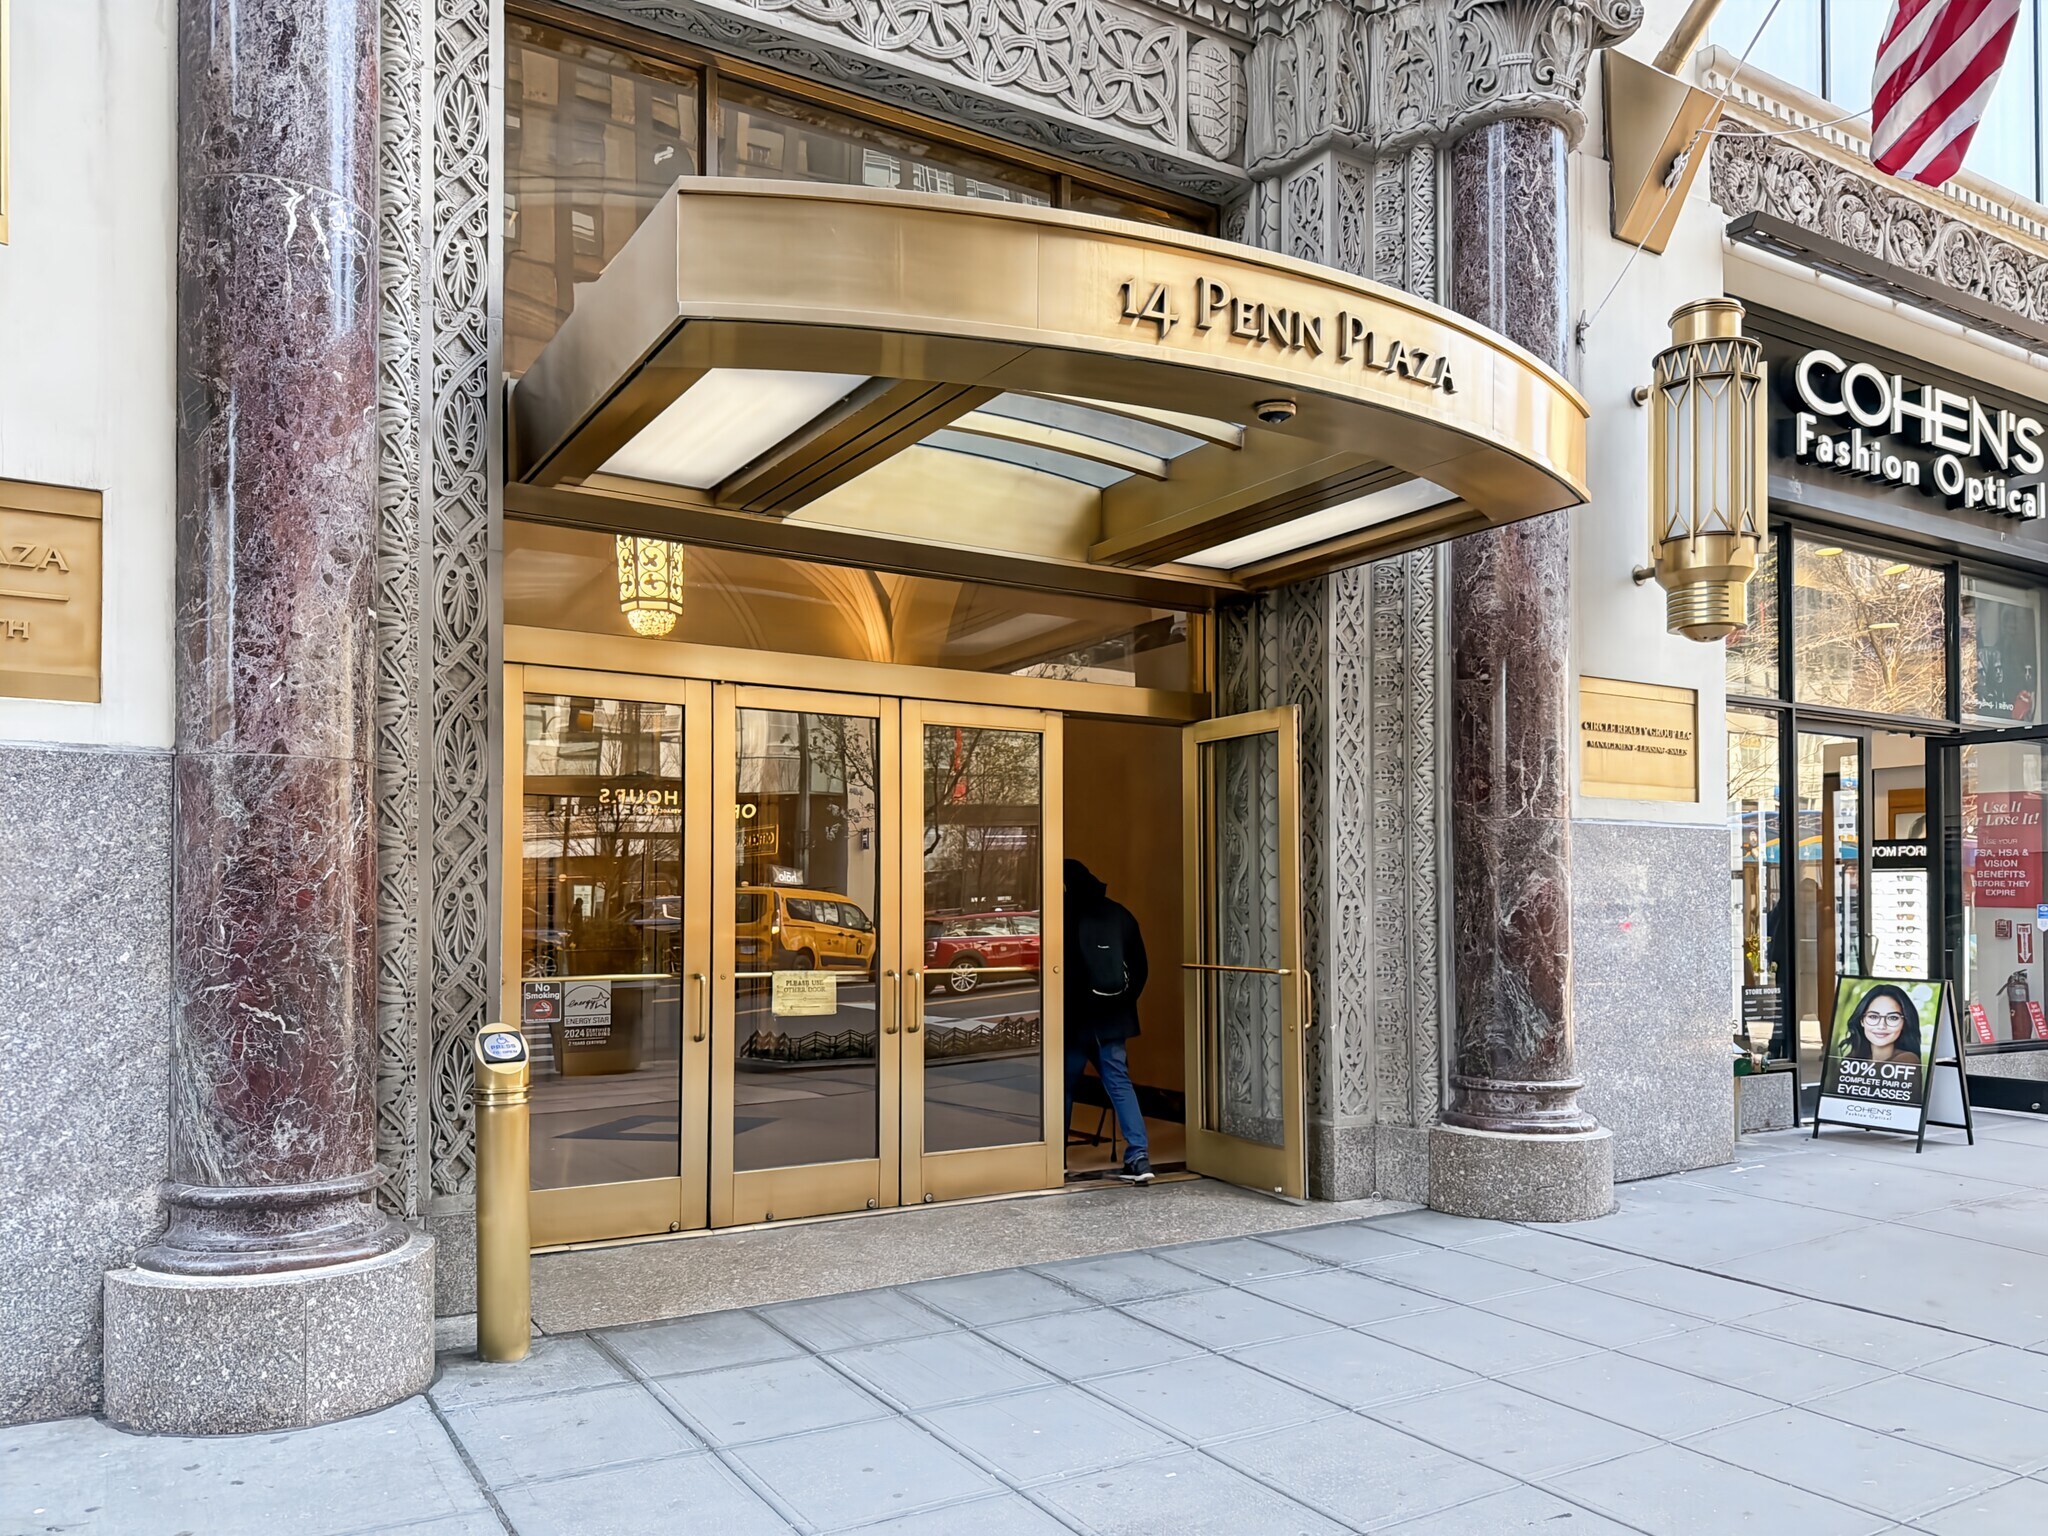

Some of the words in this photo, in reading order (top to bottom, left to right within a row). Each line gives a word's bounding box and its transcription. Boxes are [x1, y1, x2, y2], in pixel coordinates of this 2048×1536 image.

[1121, 277, 1179, 339] 14
[1197, 276, 1323, 354] PENN
[1340, 311, 1458, 394] PLAZA
[1795, 350, 2045, 475] COHEN'S
[1796, 412, 1919, 486] Fashion
[1934, 454, 2046, 519] Optical
[0, 543, 69, 573] ZA
[1983, 802, 2007, 814] Use
[2011, 801, 2022, 813] It
[1985, 814, 2019, 826] Lose
[2022, 813, 2040, 825] It!
[1974, 849, 1996, 857] FSA,
[1998, 849, 2019, 857] HSA
[2022, 849, 2029, 857] &
[1984, 859, 2018, 867] VISION
[1977, 870, 2026, 878] BENEFITS
[535, 983, 550, 992] No
[525, 992, 560, 1000] Smoking
[566, 999, 596, 1010] energy
[565, 1017, 592, 1025] ENERGY
[592, 1016, 610, 1024] STAR
[564, 1029, 585, 1038] 2024
[1840, 1060, 1876, 1077] 30%
[1881, 1064, 1916, 1080] OFF
[1839, 1075, 1880, 1086] COMPLETE
[1882, 1080, 1900, 1088] PAIR
[1846, 1104, 1892, 1116] COHEN'S
